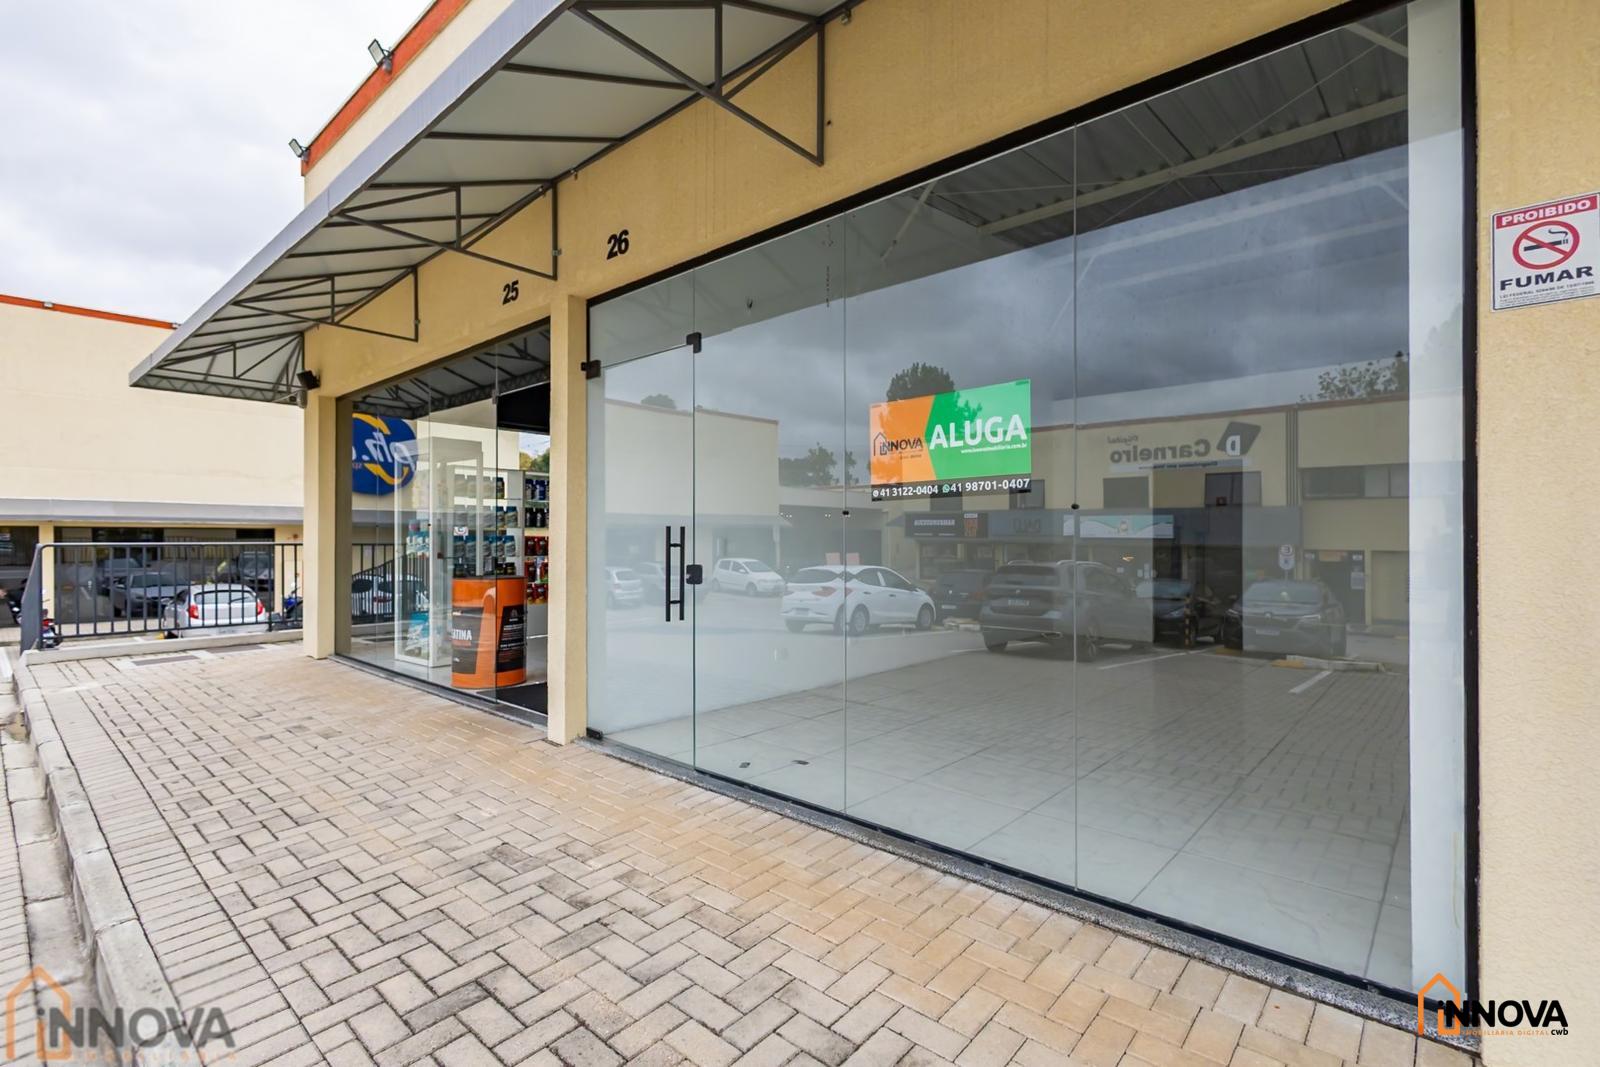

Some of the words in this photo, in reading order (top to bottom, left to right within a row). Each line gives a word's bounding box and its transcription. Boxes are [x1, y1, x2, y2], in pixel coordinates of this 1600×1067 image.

[1502, 200, 1591, 226] PROIBIDO
[606, 229, 629, 260] 26
[1500, 266, 1594, 291] FUMAR
[503, 280, 519, 305] 25
[929, 414, 1028, 450] ALUGA
[880, 488, 890, 497] 41
[892, 485, 938, 496] 3122-0404
[950, 484, 962, 492] 41
[965, 478, 1031, 490] 98701-0407
